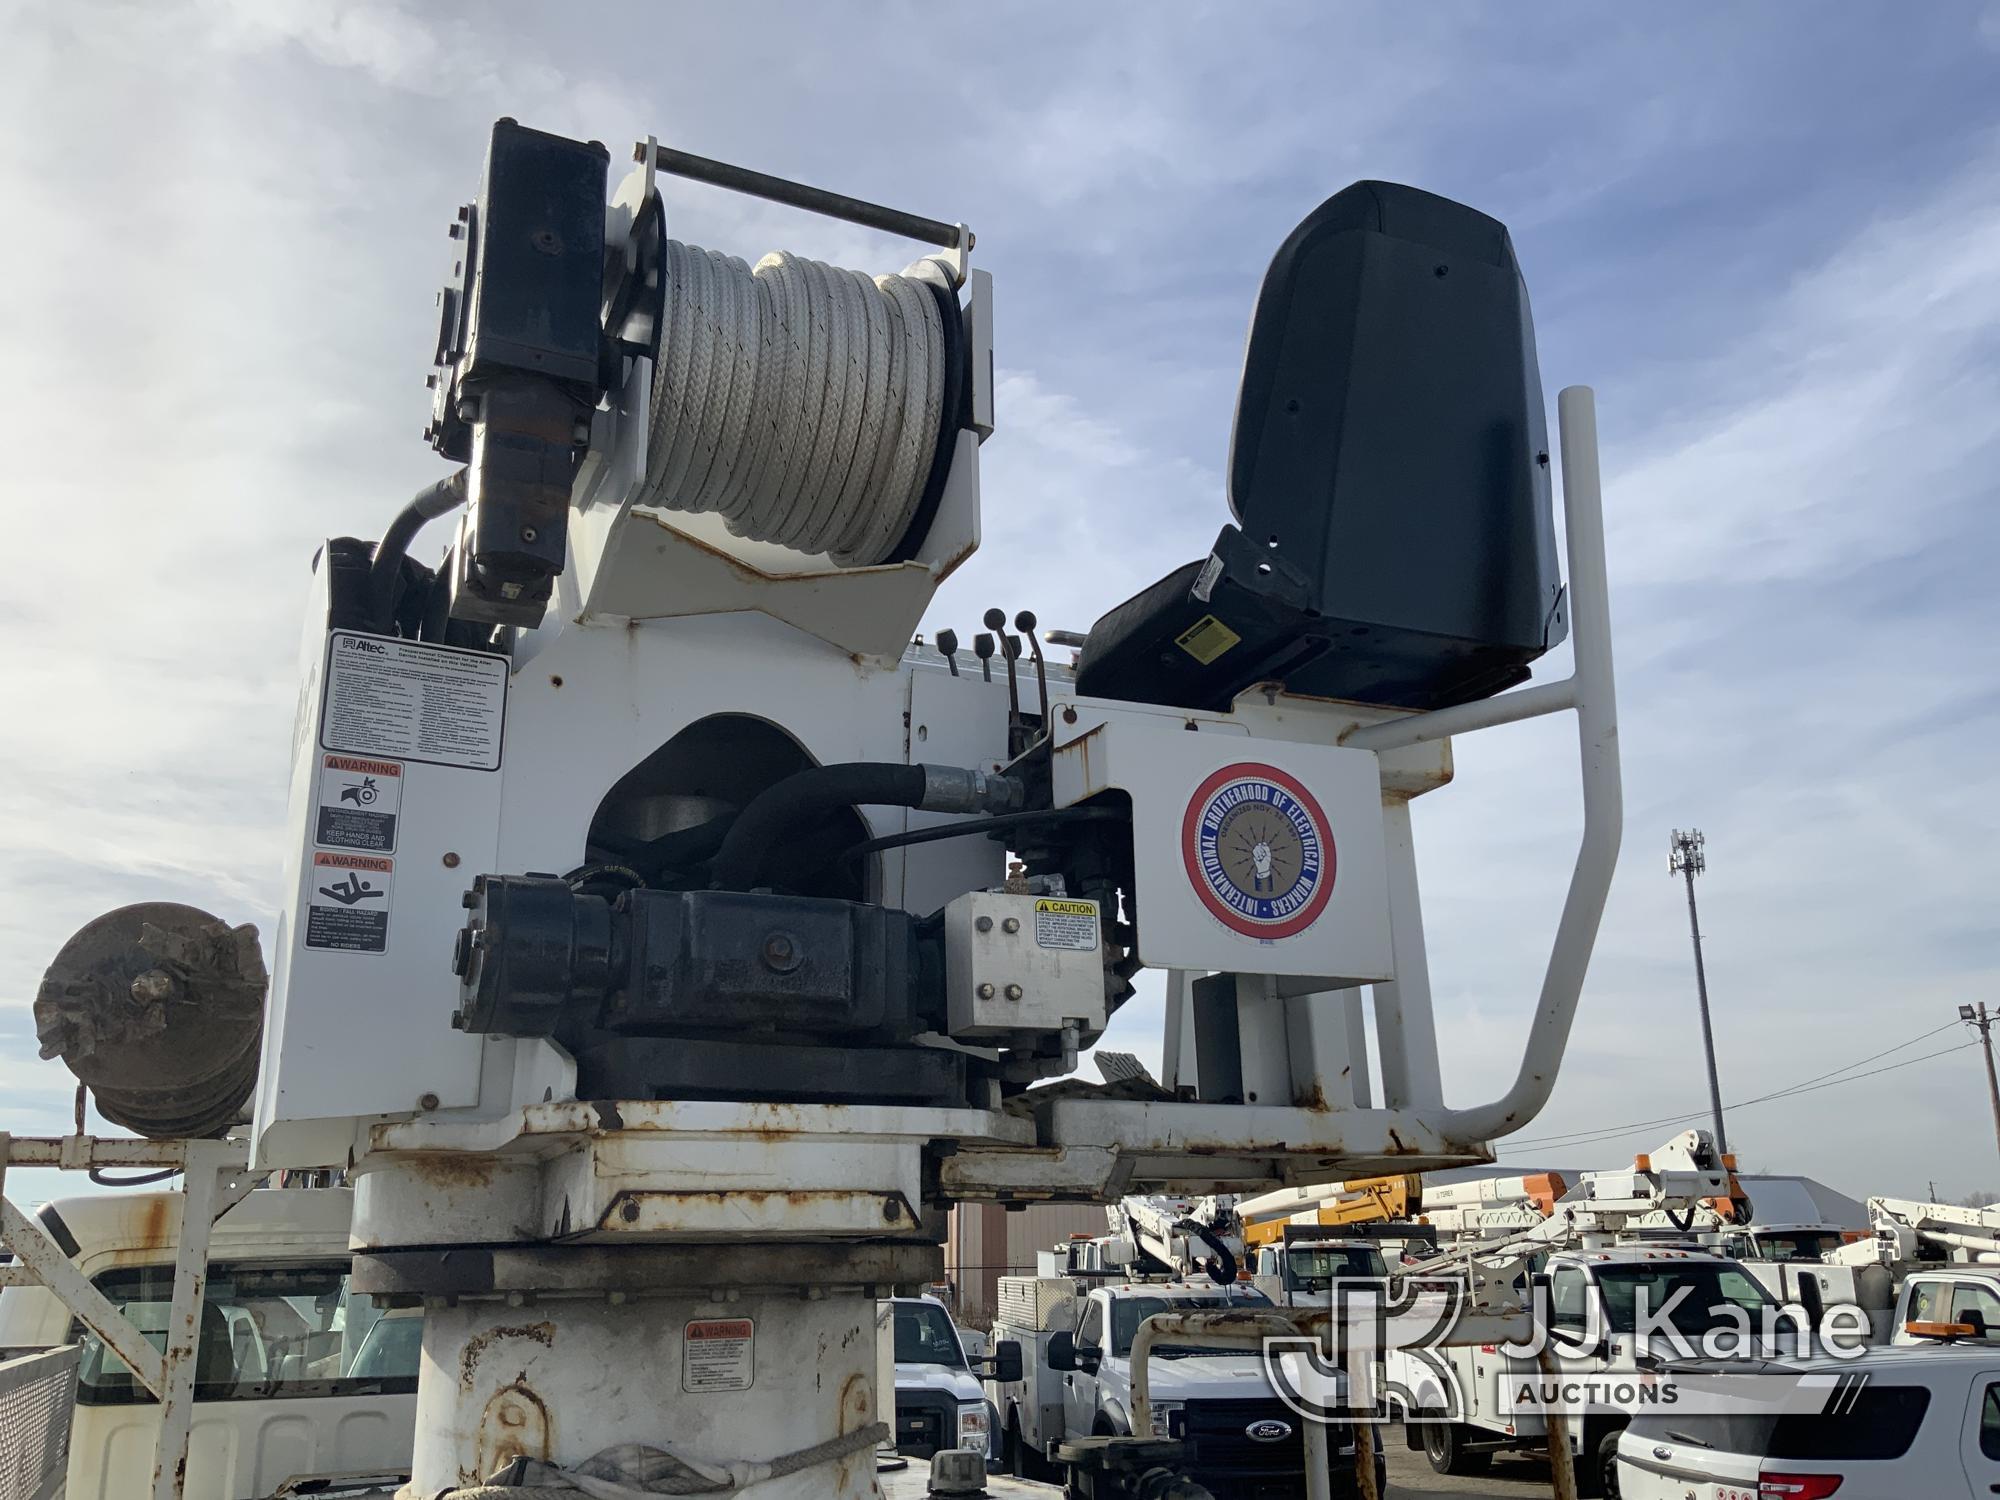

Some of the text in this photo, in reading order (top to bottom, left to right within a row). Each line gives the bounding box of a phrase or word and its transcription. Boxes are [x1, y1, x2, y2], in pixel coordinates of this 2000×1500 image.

[356, 641, 385, 654] Altec
[339, 759, 398, 776] WARNING
[1204, 784, 1269, 830] BROTHERHOOD
[1273, 791, 1287, 808] OF
[1221, 805, 1251, 838] ORGANIZED
[327, 836, 360, 845] CLOTHING
[1286, 805, 1318, 872] ELECTRICAL
[332, 856, 387, 870] WARNING
[1202, 835, 1258, 916] INTERNATIONAL
[1271, 875, 1314, 917] WORKERS
[1053, 903, 1092, 914] CAUTION
[706, 1325, 746, 1336] WARNING
